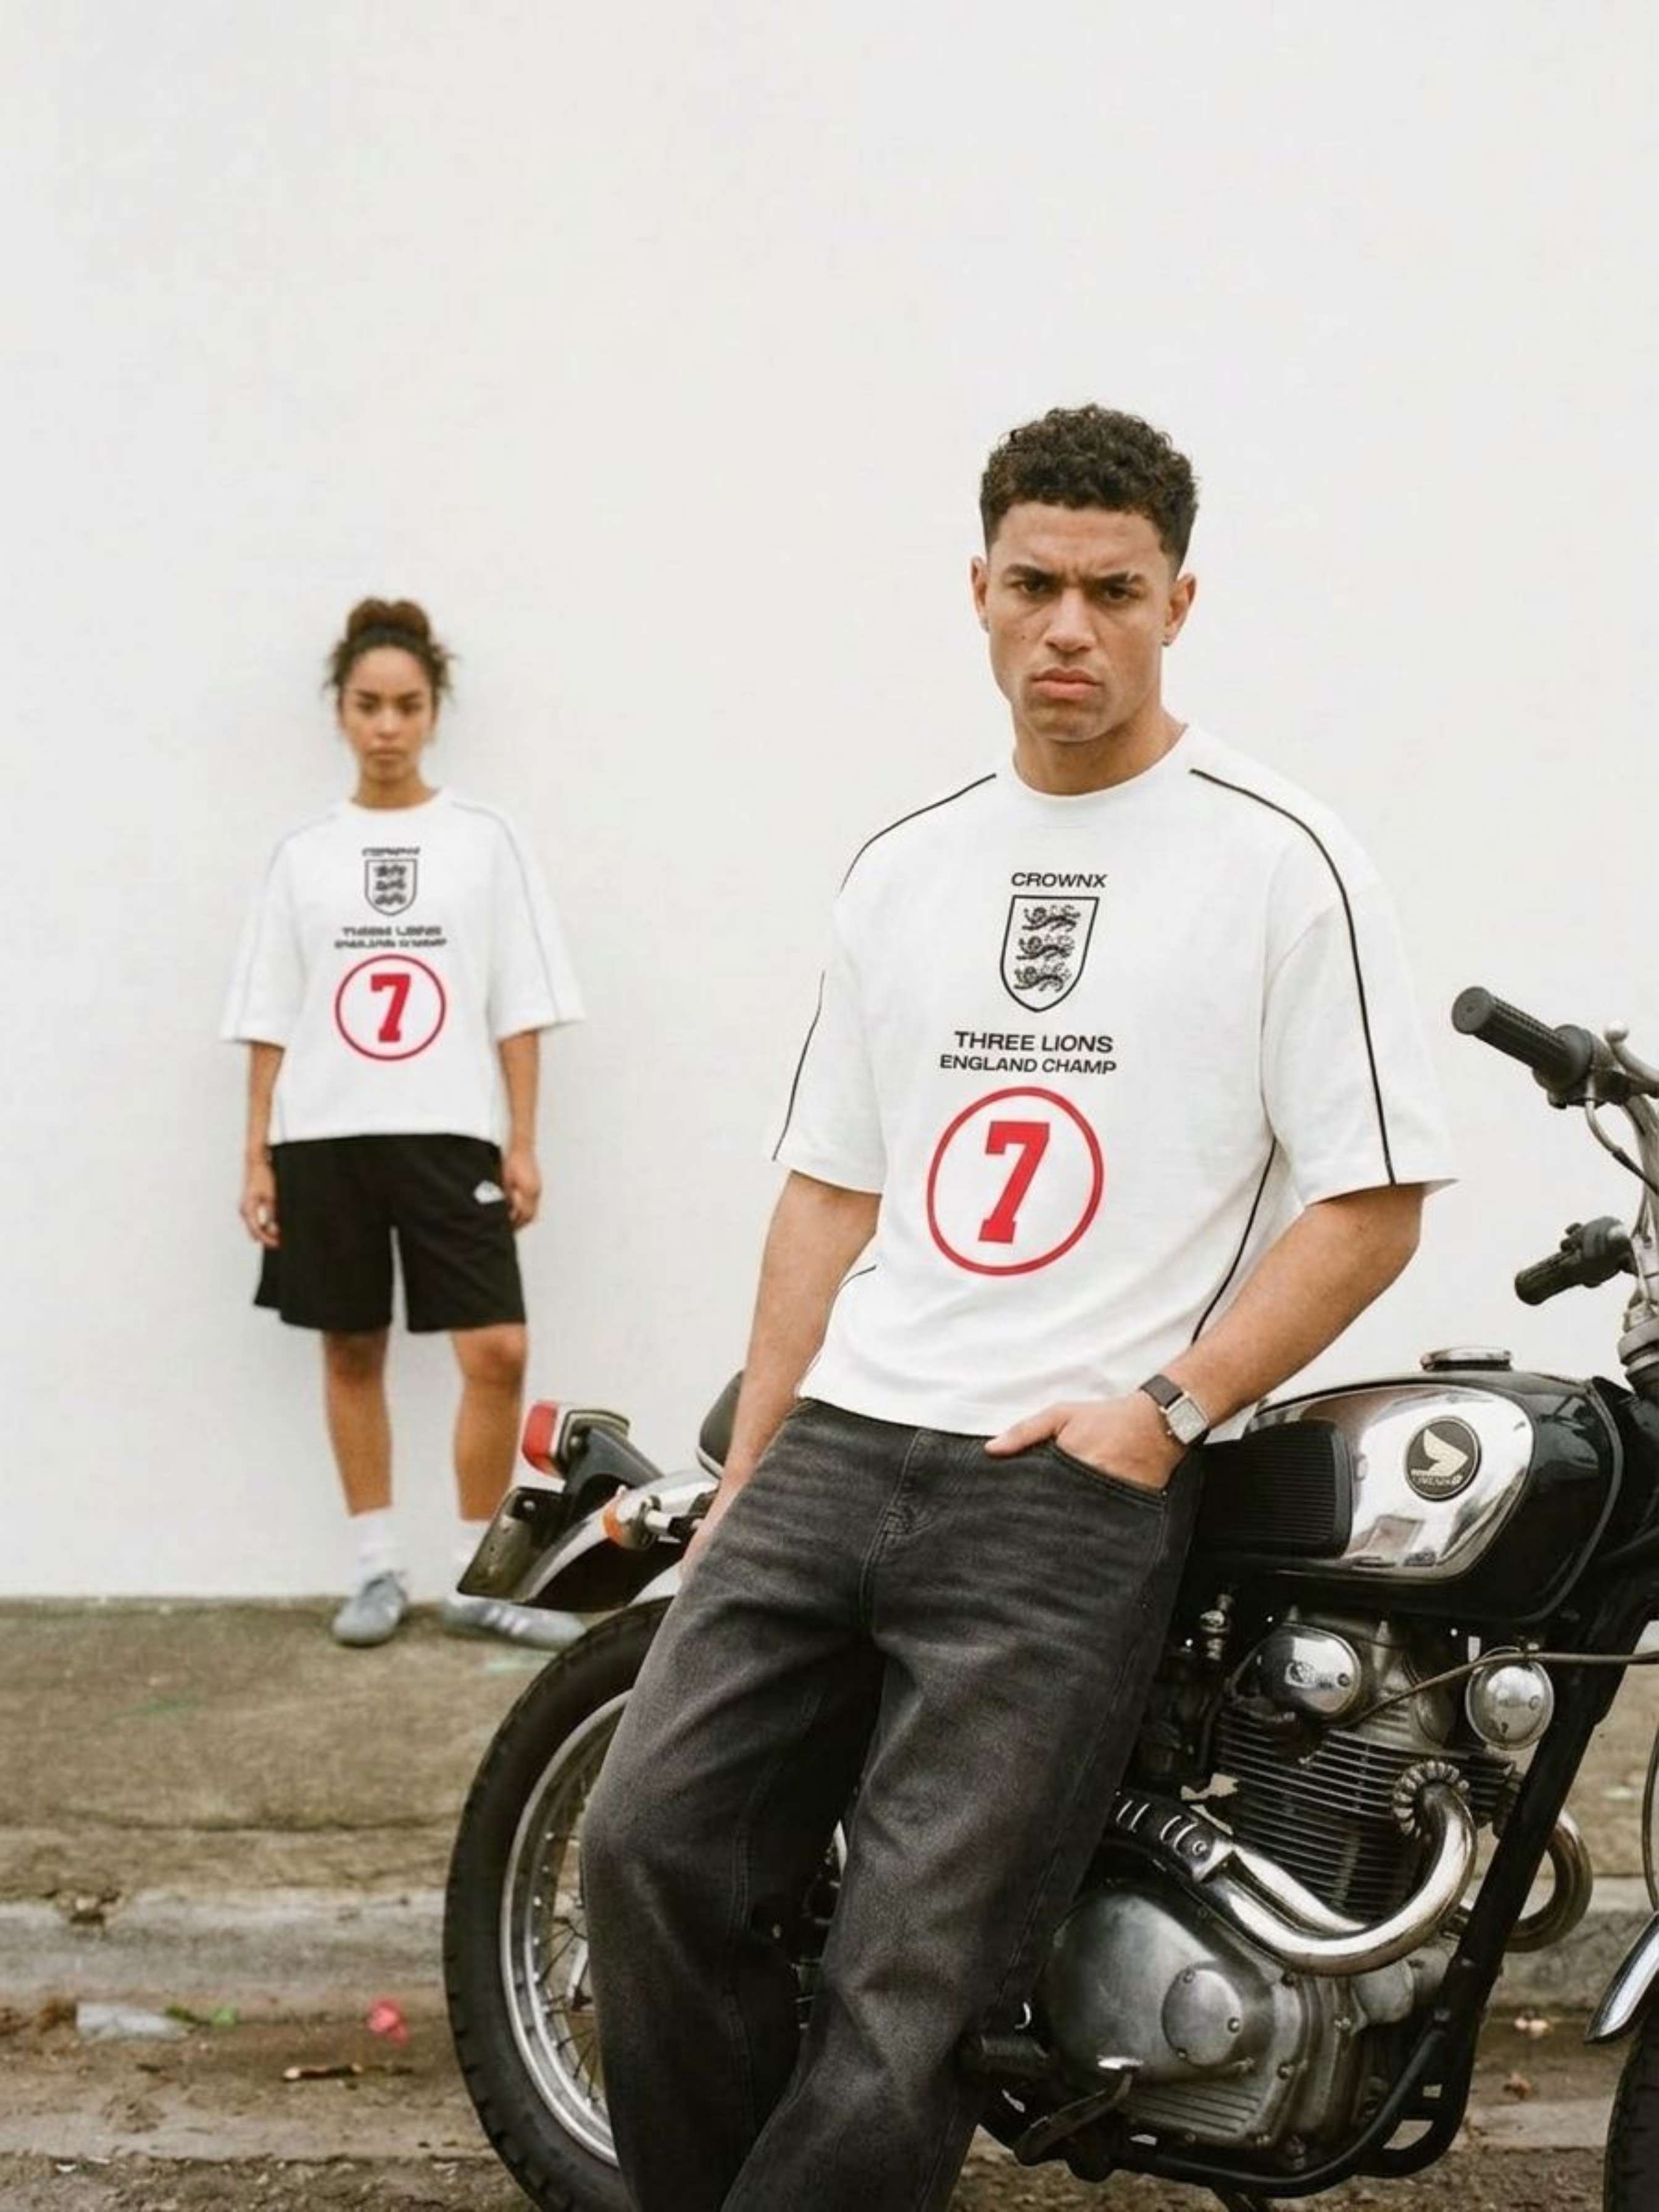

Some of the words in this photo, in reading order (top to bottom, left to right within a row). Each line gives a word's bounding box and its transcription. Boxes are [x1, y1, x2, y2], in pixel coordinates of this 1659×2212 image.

[1011, 872, 1108, 888] CROWNX
[370, 972, 412, 1043] 7
[954, 1031, 1036, 1051] THREE
[1041, 1034, 1113, 1054] LIONS
[939, 1054, 1037, 1073] ENGLAND
[1042, 1058, 1116, 1075] CHAMP
[978, 1120, 1050, 1244] 7
